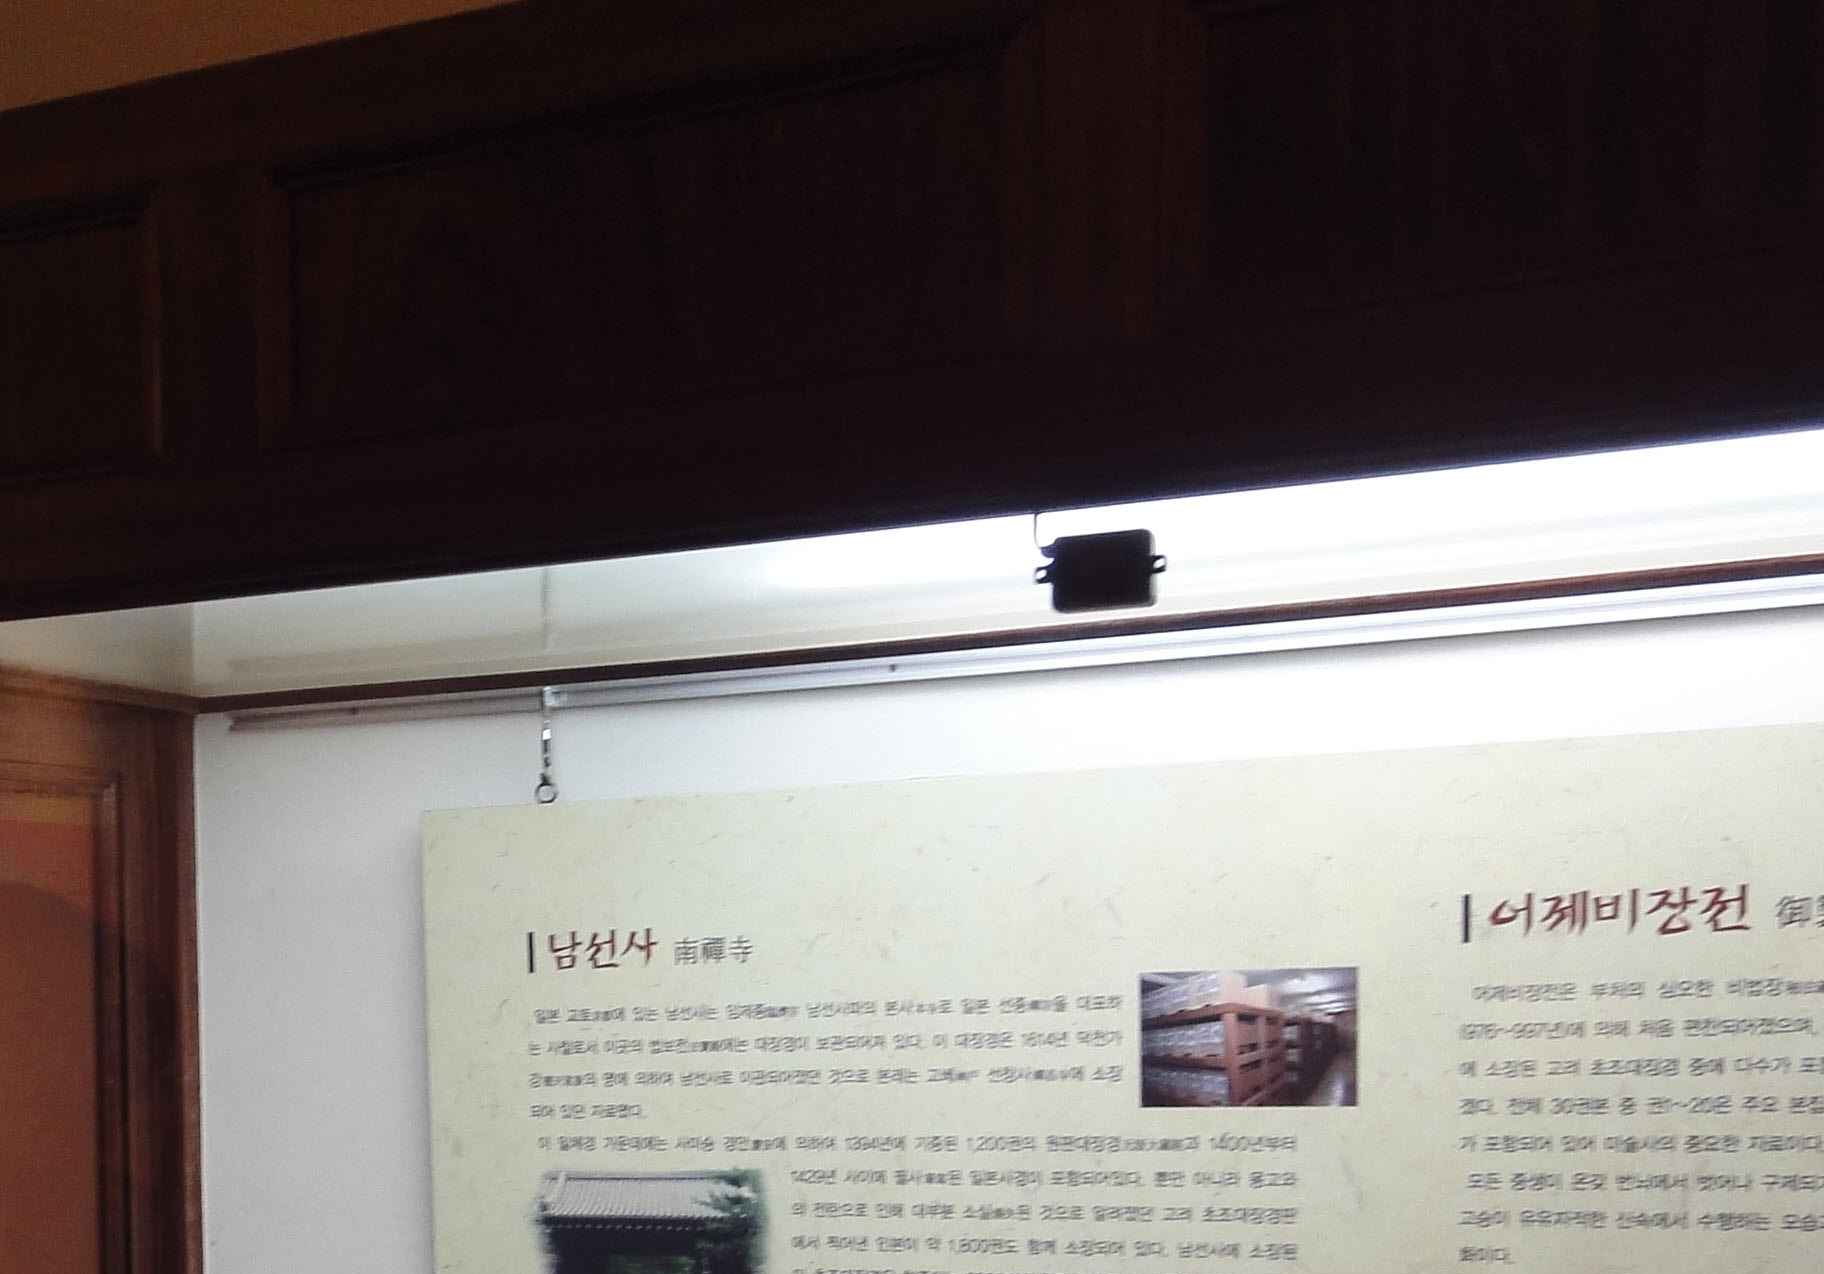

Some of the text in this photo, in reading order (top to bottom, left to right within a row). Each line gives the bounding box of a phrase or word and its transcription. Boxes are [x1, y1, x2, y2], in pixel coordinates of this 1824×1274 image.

[1487, 883, 1751, 936] 어제비장전
[547, 927, 658, 971] 남선사
[1798, 1055, 1824, 1075] 포
[1780, 1213, 1824, 1232] 모습
